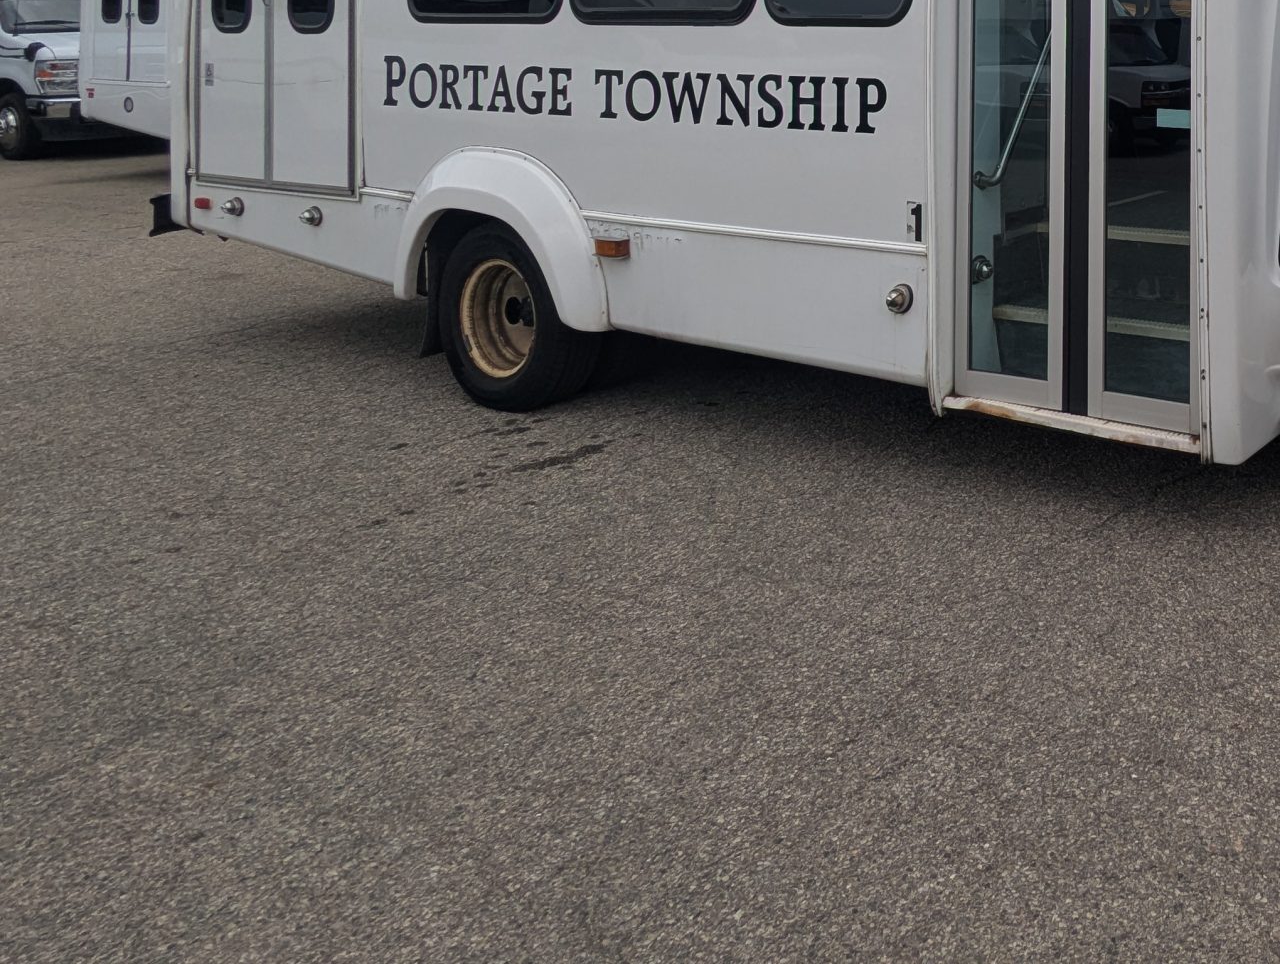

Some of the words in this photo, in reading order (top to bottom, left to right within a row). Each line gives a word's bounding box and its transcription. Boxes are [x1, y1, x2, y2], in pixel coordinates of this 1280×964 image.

[383, 54, 572, 117] PORTAGE
[594, 69, 887, 134] TOWNSHIP
[911, 204, 922, 242] 1
